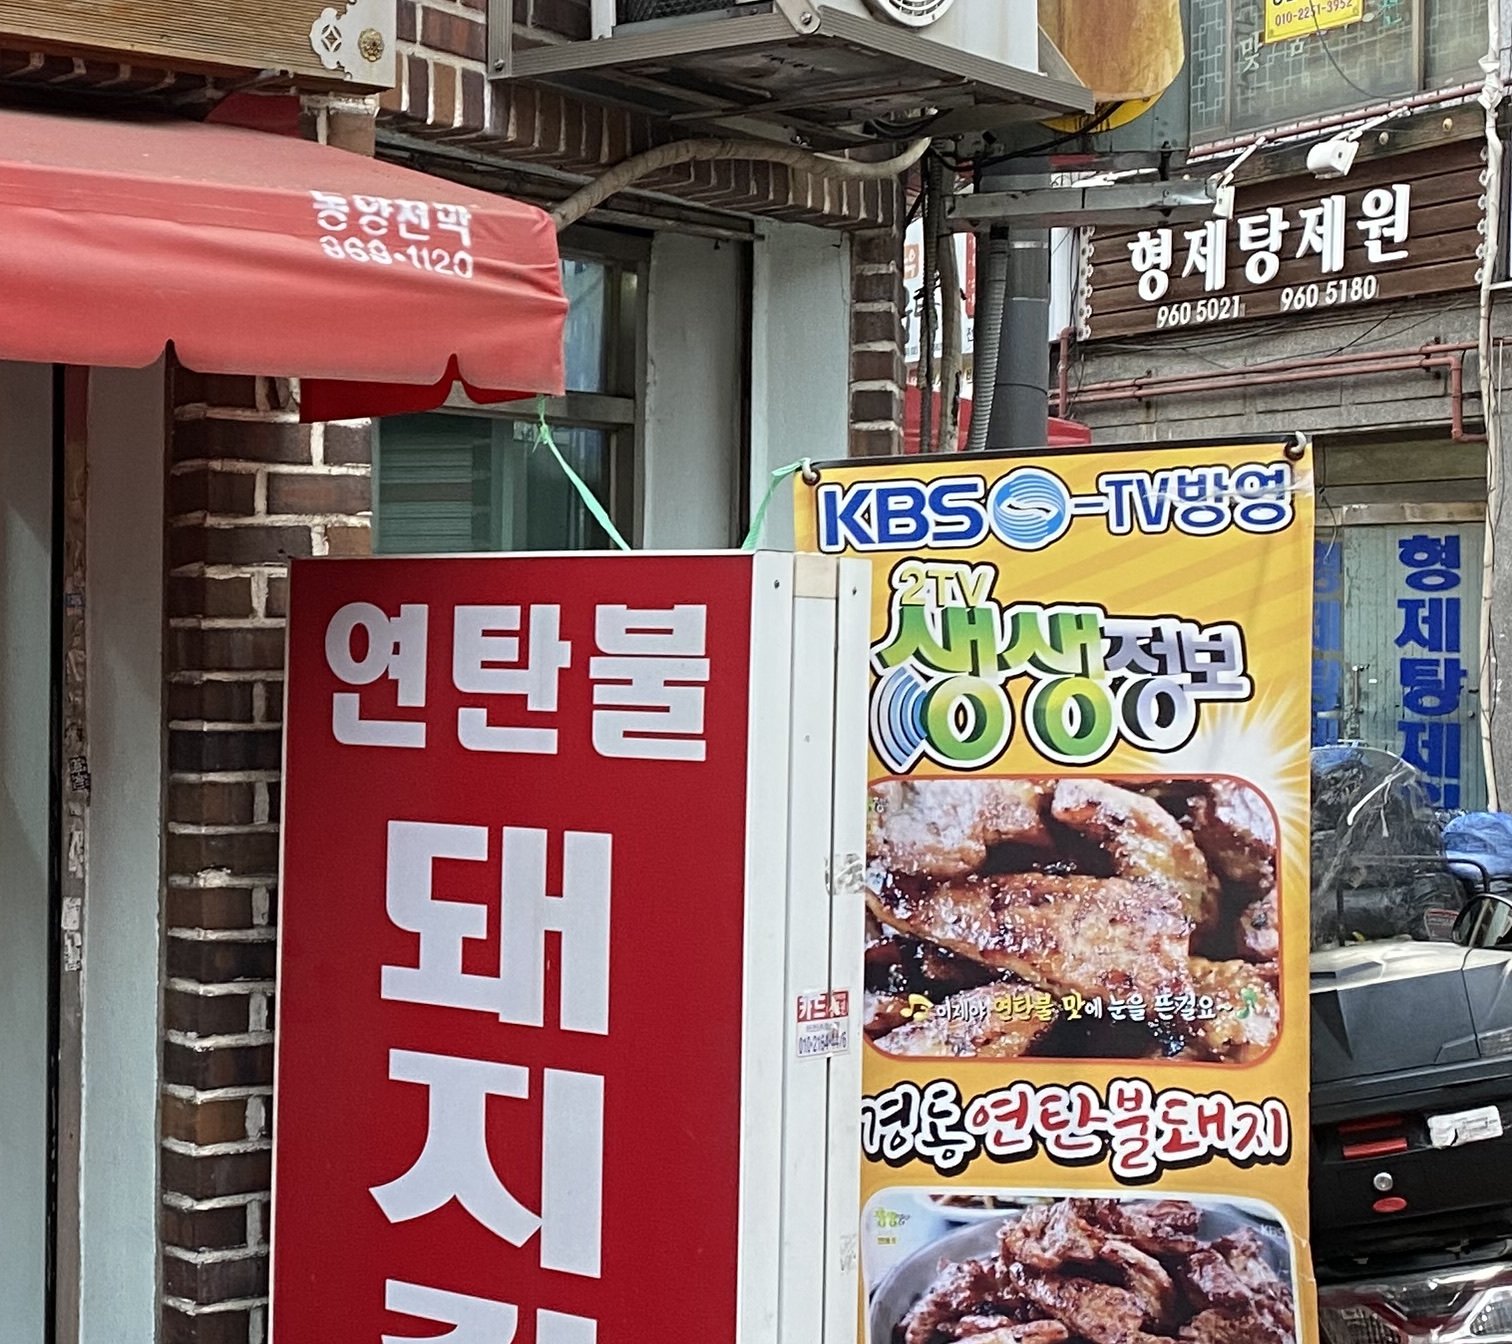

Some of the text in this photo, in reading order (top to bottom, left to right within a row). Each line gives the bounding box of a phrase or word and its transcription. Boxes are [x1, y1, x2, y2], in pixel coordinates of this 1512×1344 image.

[1126, 182, 1411, 301] 형제탕제원
[1156, 295, 1242, 329] 960 5021
[1280, 274, 1378, 312] 960 5180
[823, 482, 985, 547] KBS
[898, 564, 995, 608] 2TV
[323, 601, 710, 762] 연탄불
[876, 605, 1248, 761] 생생정보
[993, 991, 1056, 1022] 연탄불
[1061, 988, 1103, 1021] 맛에
[1107, 993, 1147, 1021] 눈을
